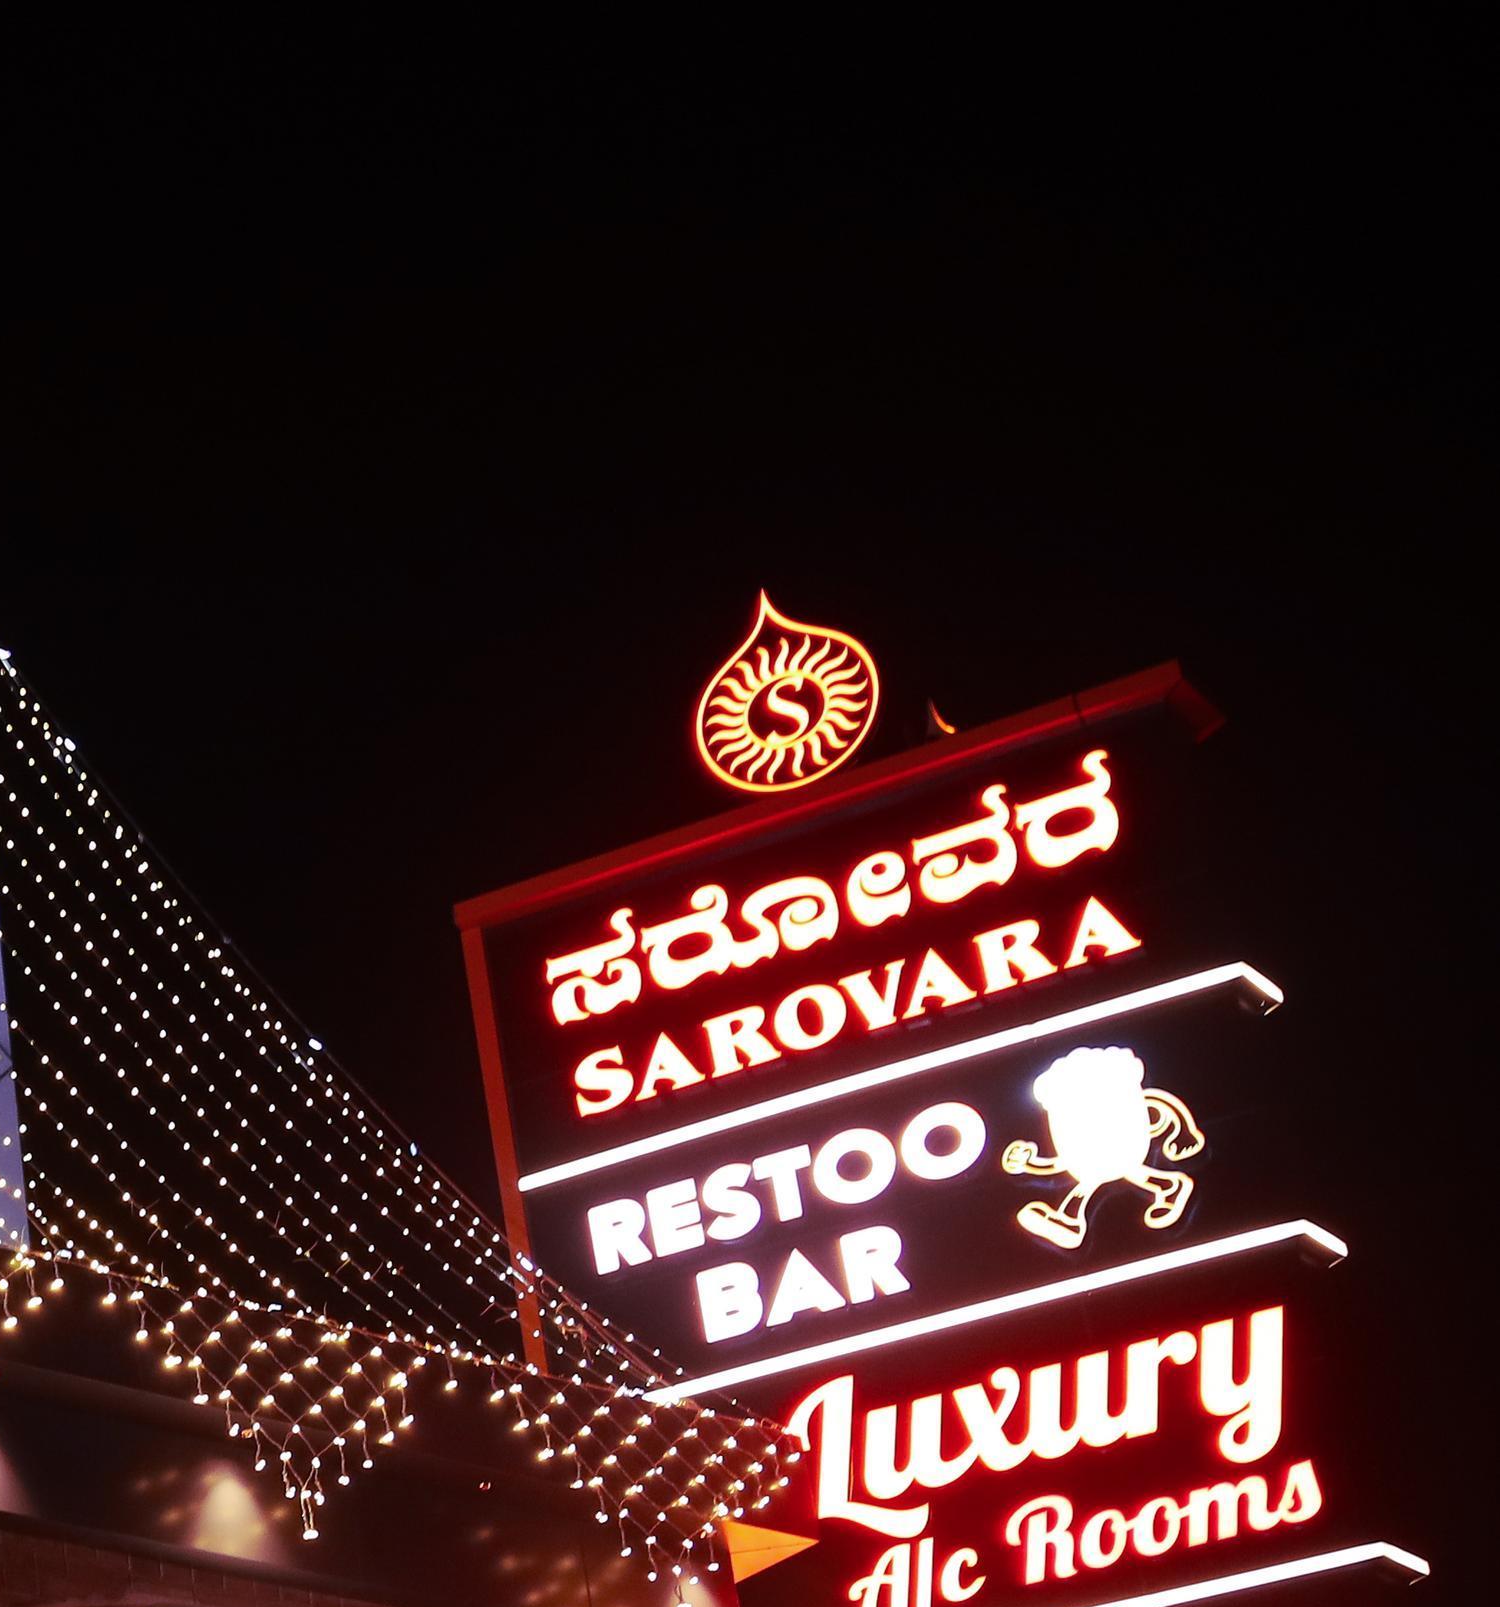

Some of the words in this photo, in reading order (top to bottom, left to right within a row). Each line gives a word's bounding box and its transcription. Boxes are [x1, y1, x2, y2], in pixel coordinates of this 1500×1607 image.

[544, 748, 1120, 1026] ಸರೋವರ
[573, 896, 1142, 1118] SAROVARA
[586, 1101, 987, 1276] RESTOO
[694, 1225, 912, 1345] BAR
[783, 1305, 1285, 1540] Luxury
[1004, 1459, 1324, 1586] Rooms
